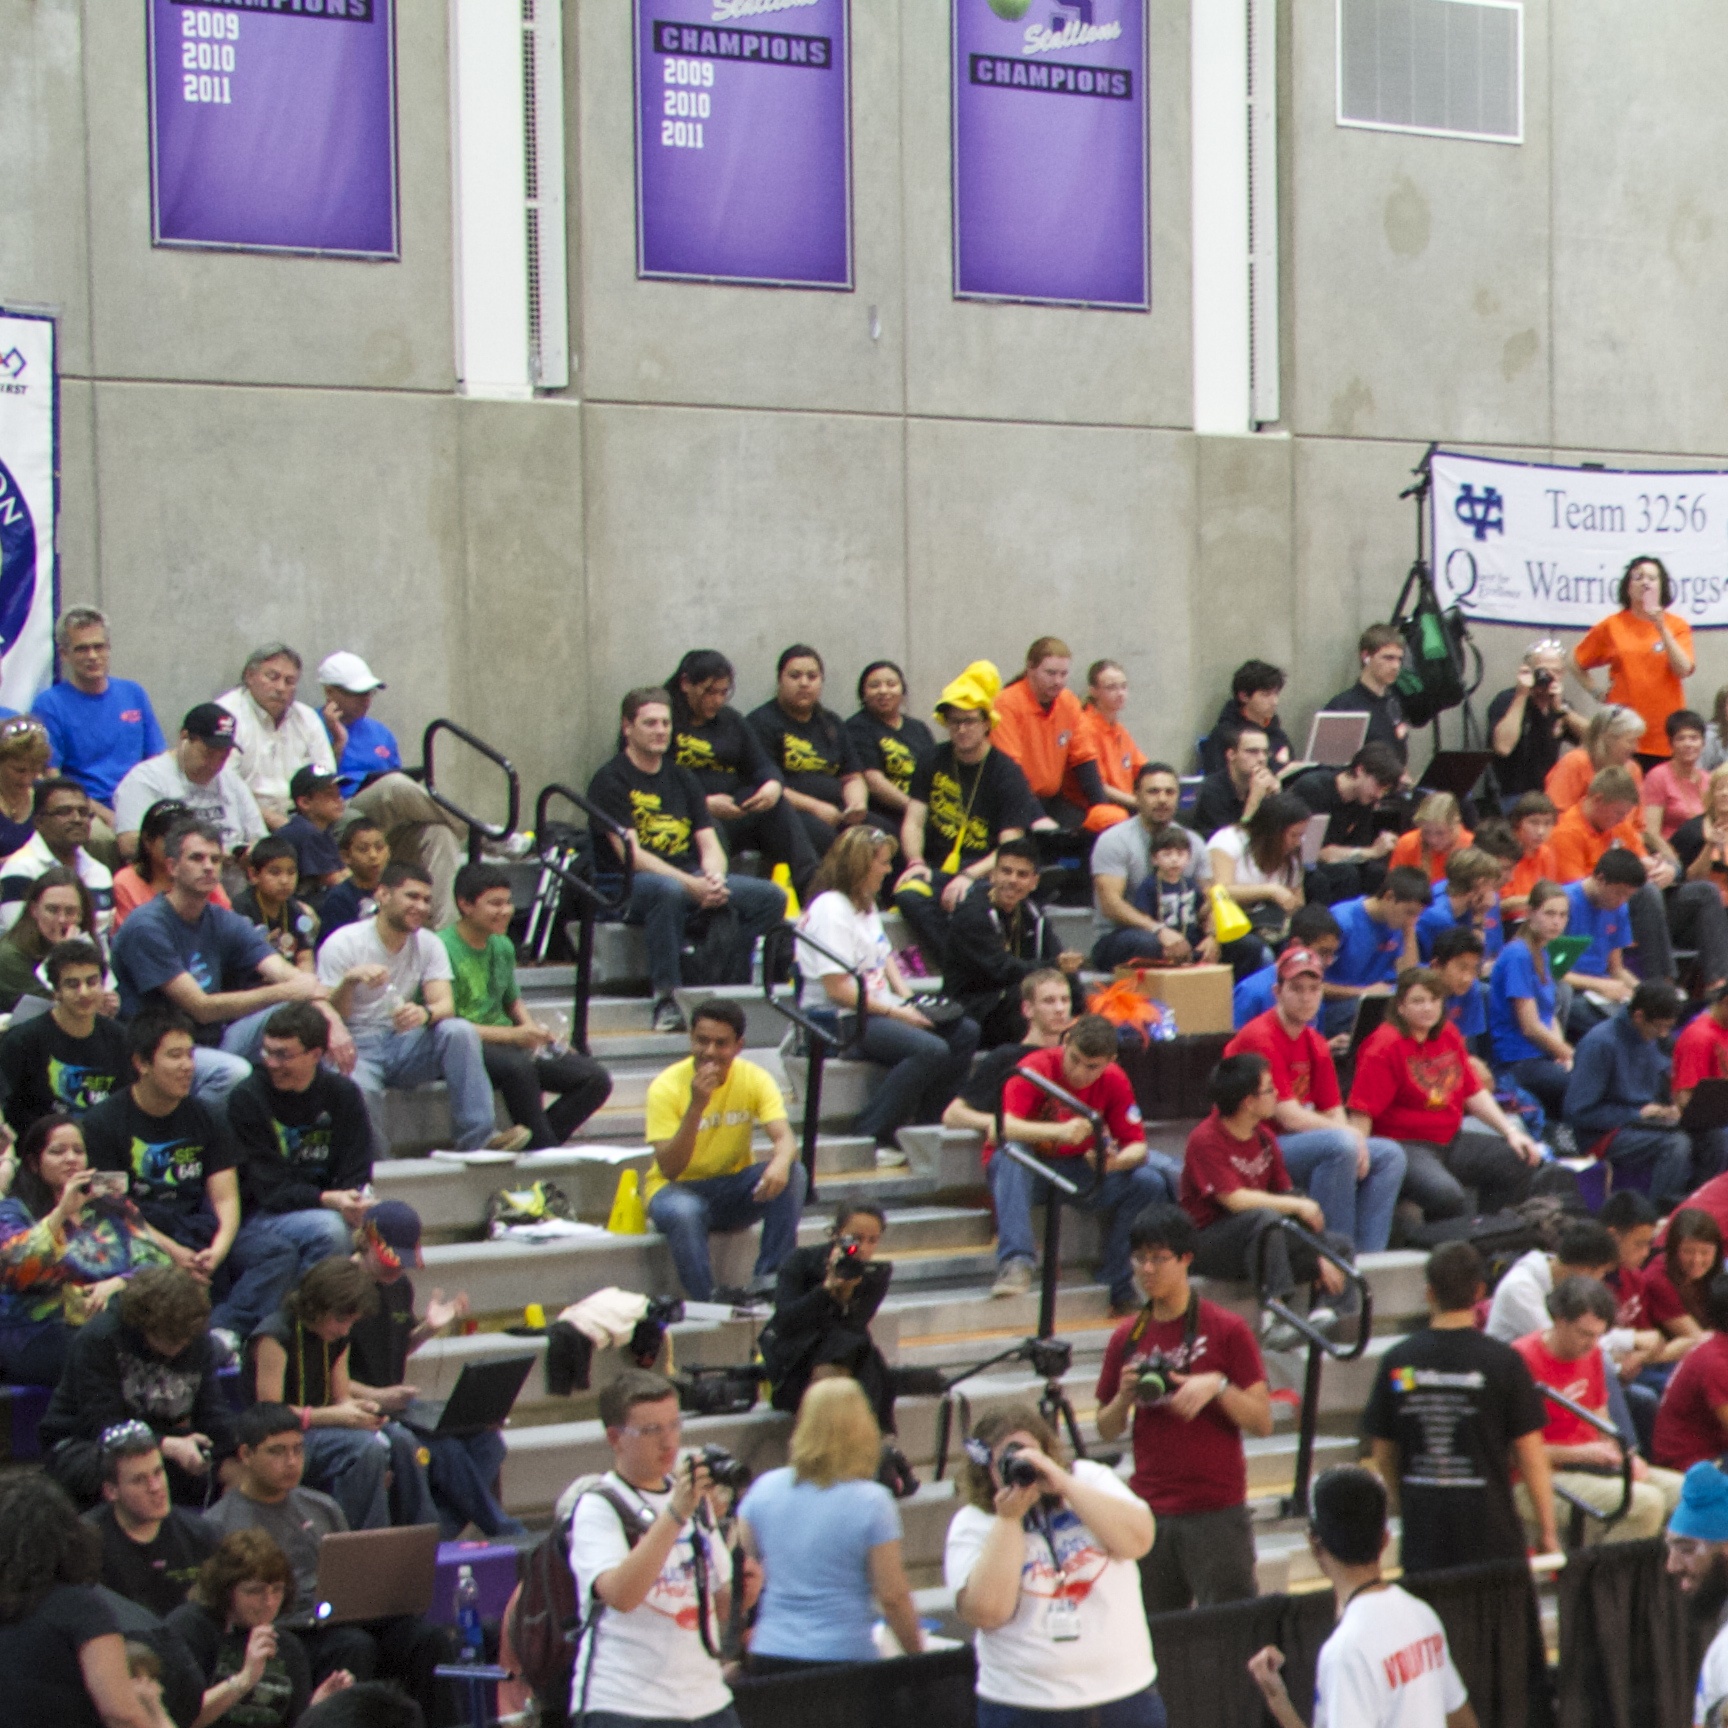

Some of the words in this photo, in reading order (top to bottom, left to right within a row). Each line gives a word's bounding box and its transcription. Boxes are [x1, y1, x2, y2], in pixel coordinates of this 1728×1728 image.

[181, 9, 240, 41] 2009
[181, 41, 236, 73] 2010
[661, 25, 827, 65] CHAMPIONS
[663, 57, 715, 88] 2009
[976, 59, 1128, 96] CHAMPIONS
[183, 73, 232, 105] 2011
[663, 89, 711, 119] 2010
[661, 120, 704, 150] 2011
[1545, 488, 1625, 532] Team
[1635, 494, 1707, 533] 3256
